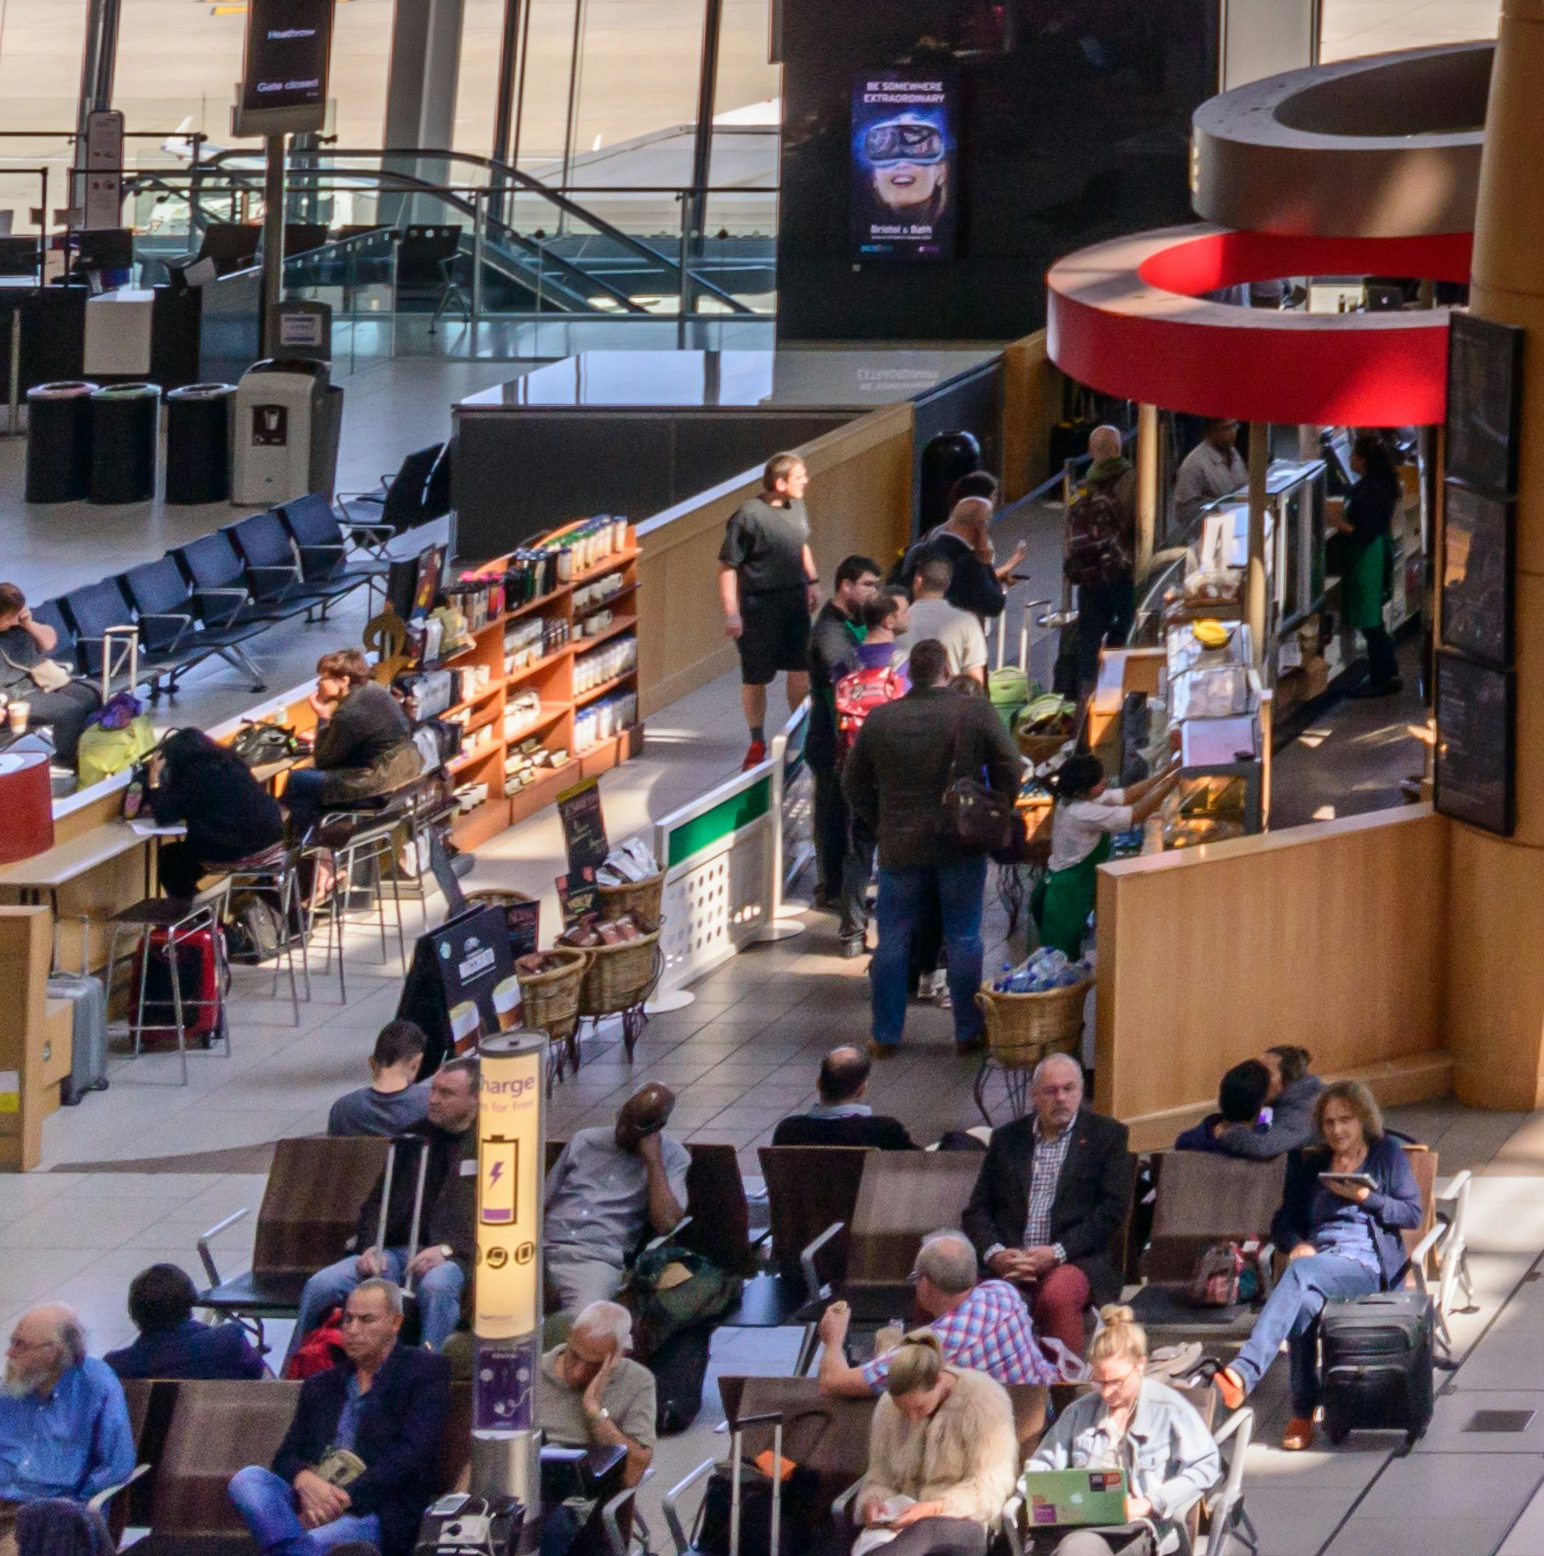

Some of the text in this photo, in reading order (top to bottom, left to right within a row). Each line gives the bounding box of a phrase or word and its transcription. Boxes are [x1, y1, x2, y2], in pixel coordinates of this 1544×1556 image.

[257, 78, 319, 92] Gate closed
[867, 82, 942, 91] BE SOMEWHERE
[864, 94, 945, 103] EXTRAORDINARY
[871, 224, 901, 234] Bristol
[911, 225, 931, 234] Bath
[480, 1073, 535, 1098] harge
